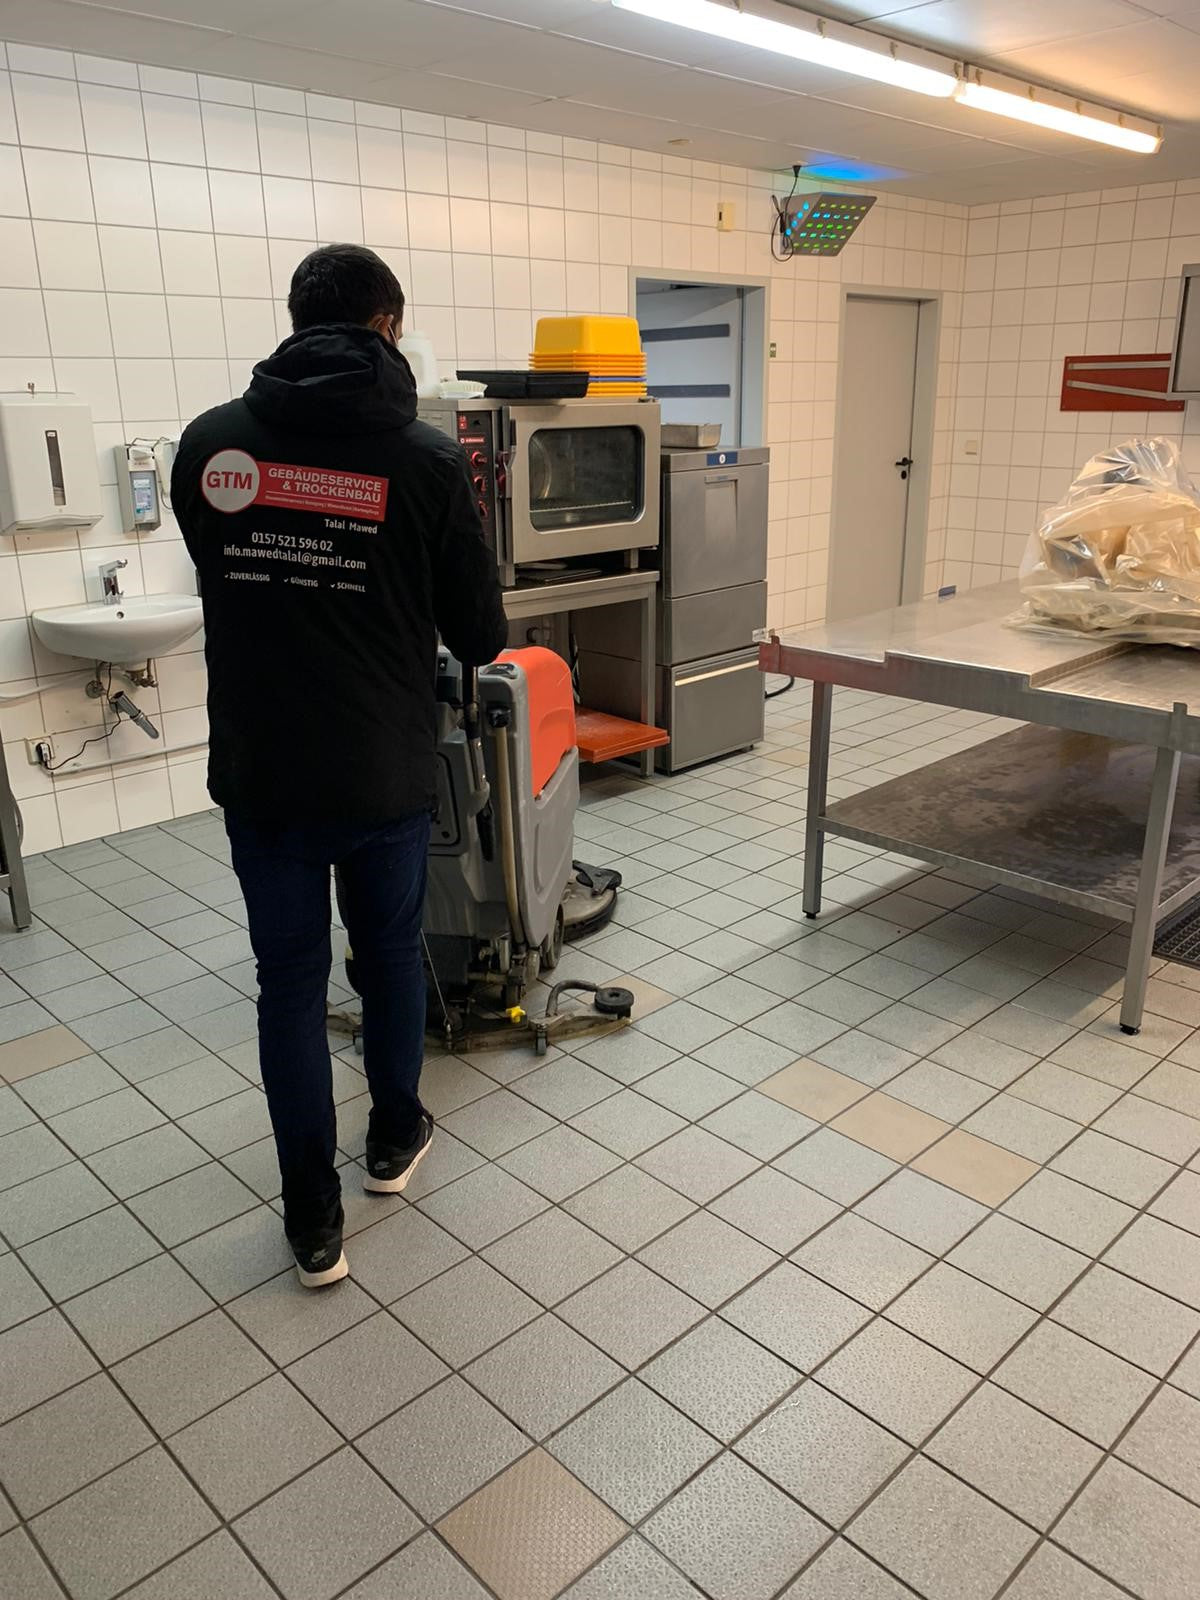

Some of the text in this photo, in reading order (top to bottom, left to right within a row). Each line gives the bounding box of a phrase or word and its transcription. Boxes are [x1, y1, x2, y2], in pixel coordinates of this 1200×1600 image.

[206, 470, 253, 490] GTM
[268, 467, 382, 493] GEBÄUDESERVICE
[282, 480, 381, 503] & TROCKENBAU
[324, 518, 378, 534] Talal Mawed
[251, 531, 334, 552] 0157 521 596 02
[223, 544, 367, 570] info.mawedtalal@gmail.com
[229, 571, 366, 593] ZUVERLÄSSIG GÜNSTIG SCHNELL
